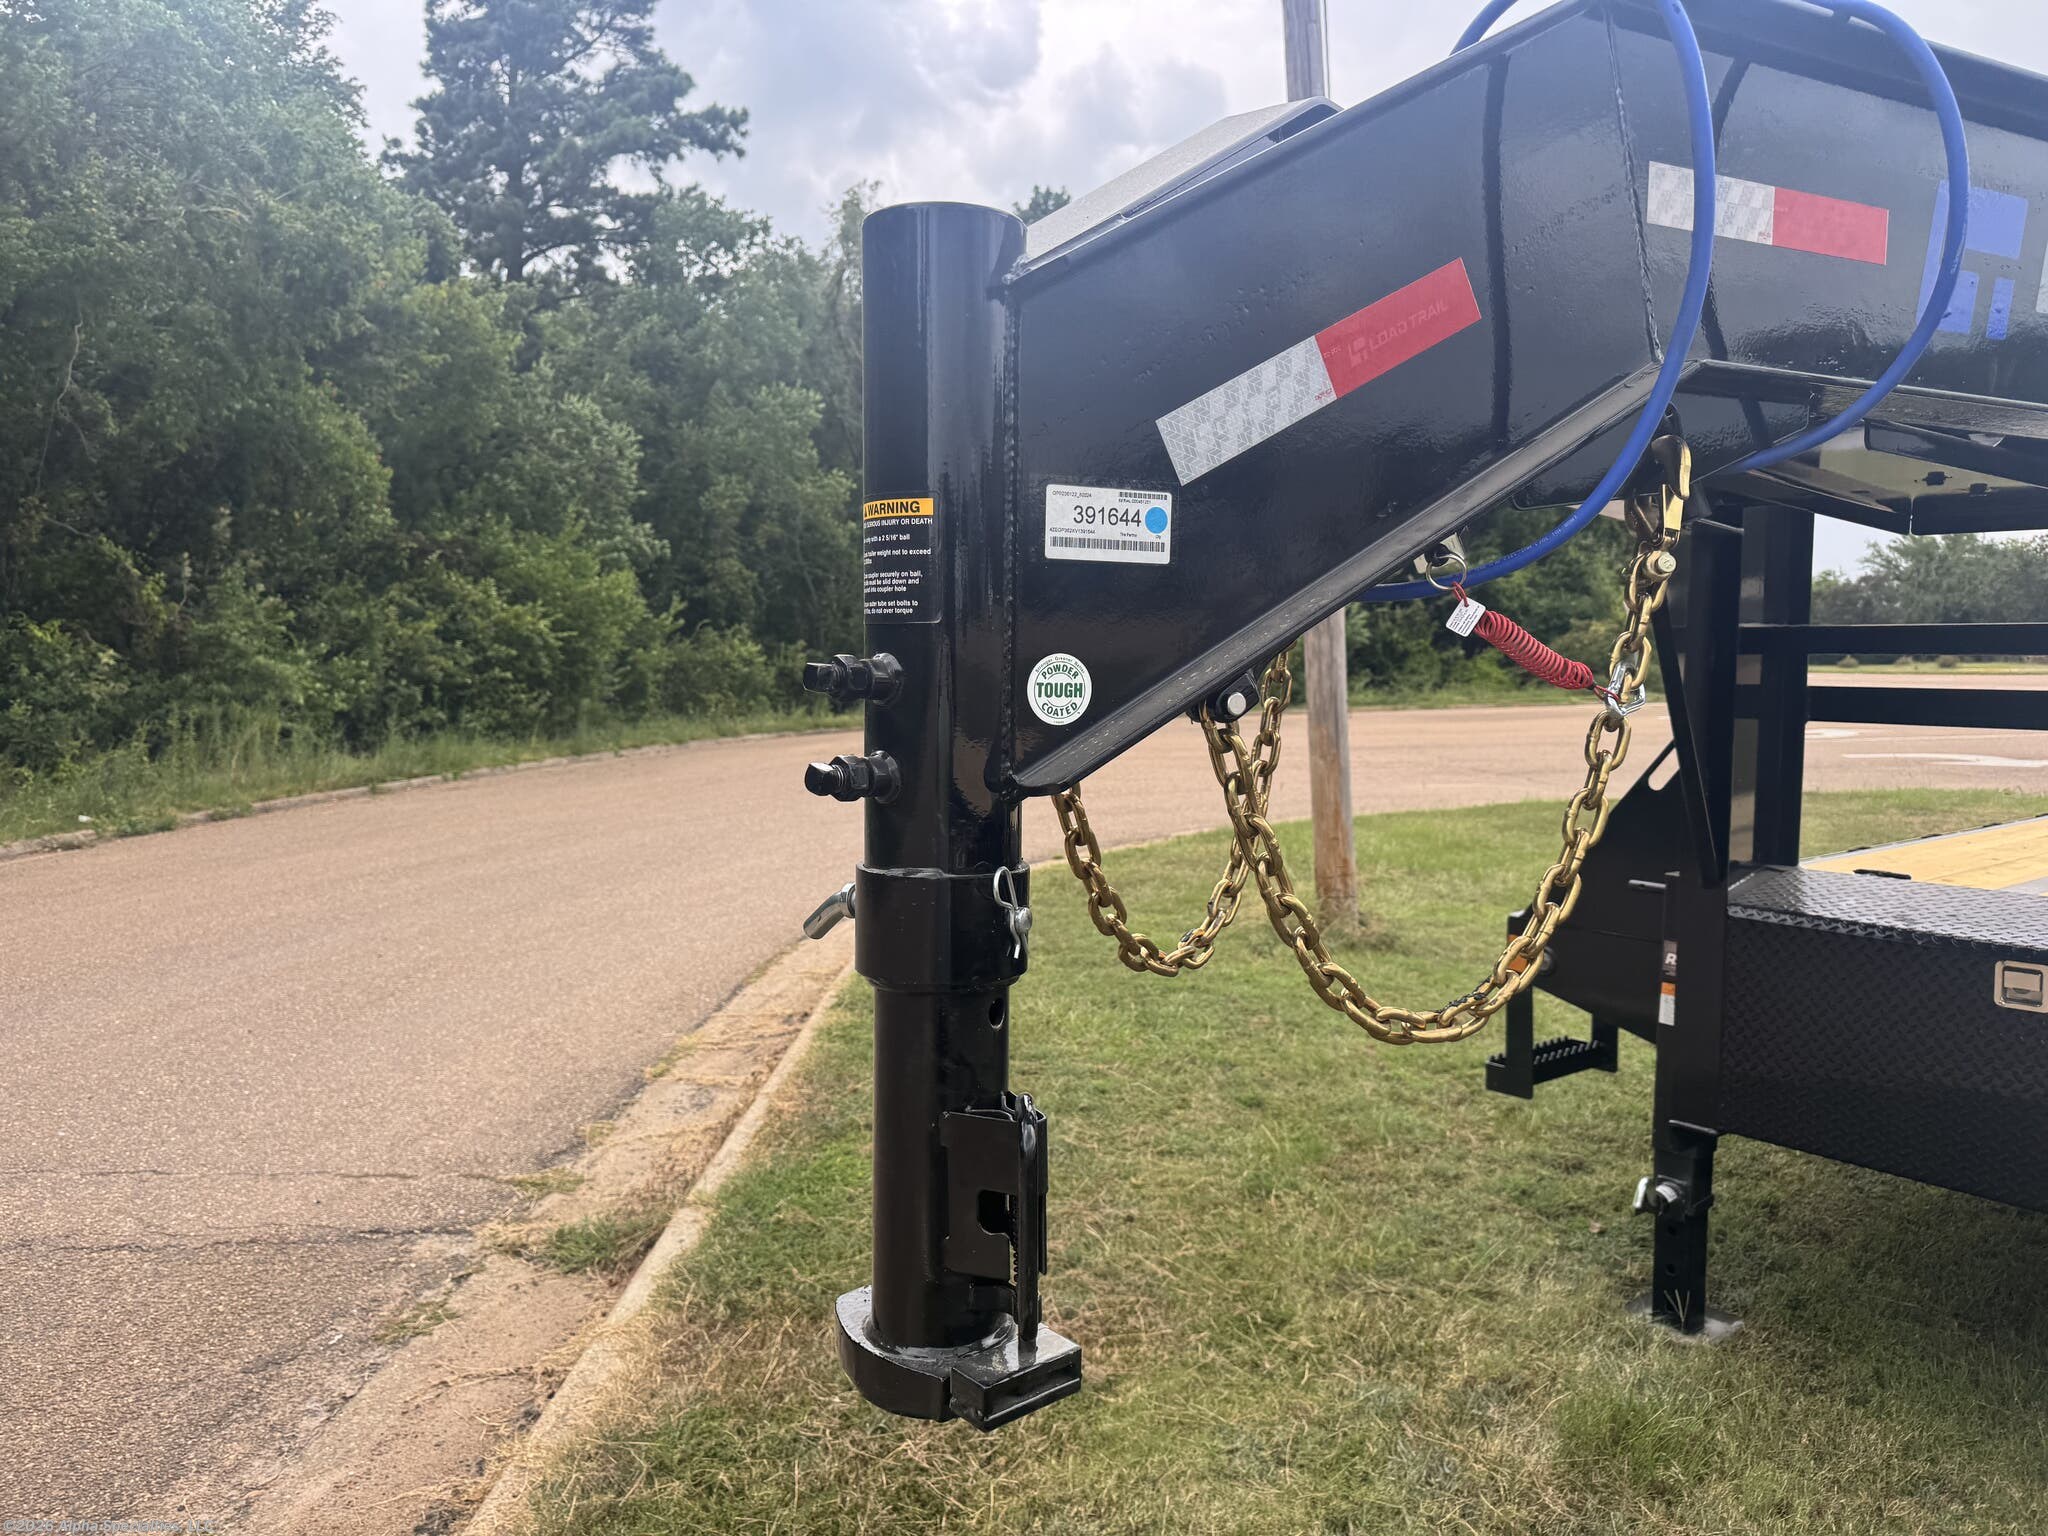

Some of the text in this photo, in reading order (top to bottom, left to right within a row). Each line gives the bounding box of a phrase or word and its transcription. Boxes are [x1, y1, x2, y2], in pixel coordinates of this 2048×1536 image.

[1368, 299, 1450, 349] LOAD TRAIL
[867, 501, 920, 516] WARNING
[1073, 505, 1141, 527] 391644
[910, 570, 923, 578] ball,
[1041, 664, 1079, 679] POWDER
[1037, 682, 1083, 698] TOUGH
[1041, 702, 1078, 717] COATED
